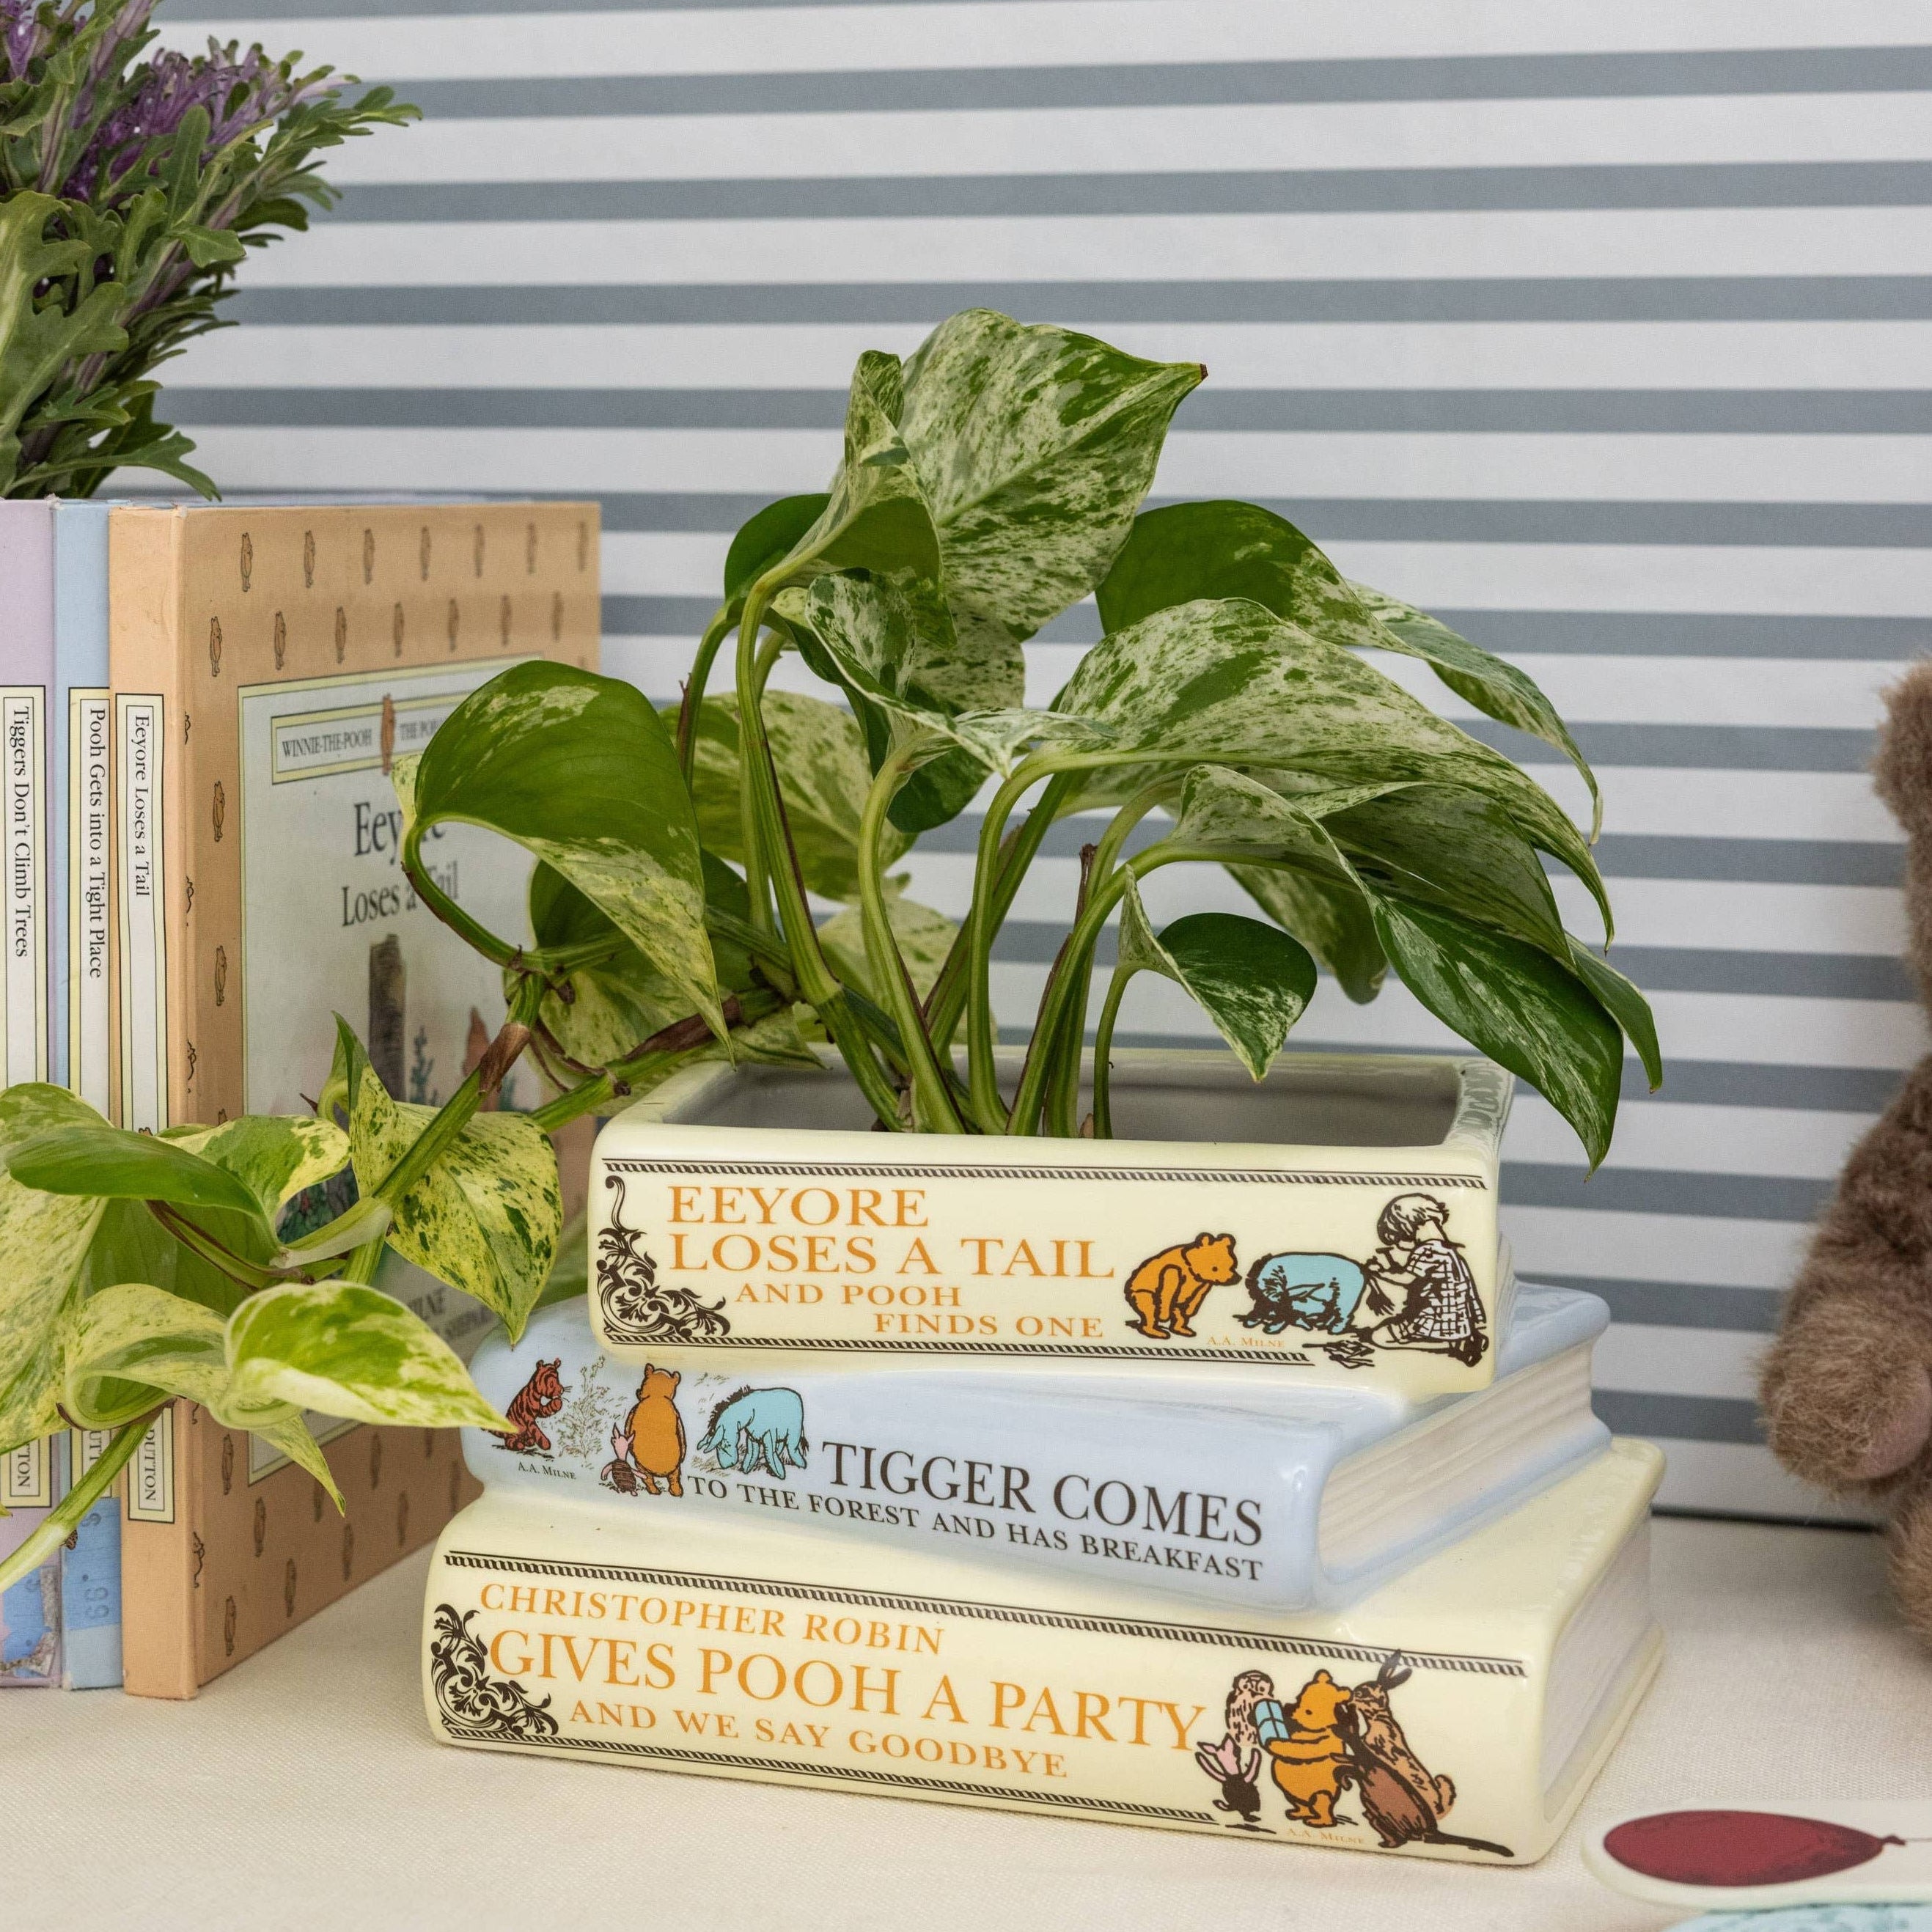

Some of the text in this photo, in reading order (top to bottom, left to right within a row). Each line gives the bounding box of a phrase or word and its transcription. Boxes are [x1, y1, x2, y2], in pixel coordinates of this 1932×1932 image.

[282, 729, 372, 759] WINNIE-THE-POOH
[10, 705, 32, 957] Tiggers Don't Climb Trees
[131, 716, 150, 896] Eeyore Loses a Tail
[85, 708, 106, 979] Pooh Gets into a Tight Place
[342, 881, 400, 927] Loses
[667, 1185, 929, 1229] EEYORE
[669, 1232, 1115, 1279] LOSES A TAIL
[735, 1283, 961, 1307] AND POOH
[873, 1312, 1103, 1339] FINDS ONE
[518, 1461, 540, 1474] A.A.
[822, 1441, 1263, 1546] TIGGER COMES
[688, 1474, 1263, 1582] TO THE FOREST AND HAS BREAKFAST
[480, 1583, 944, 1656] CHRISTOPHER ROBIN
[490, 1629, 1207, 1752] GIVES POOH A PARTY
[570, 1700, 1068, 1779] AND WE SAY GOODBYE
